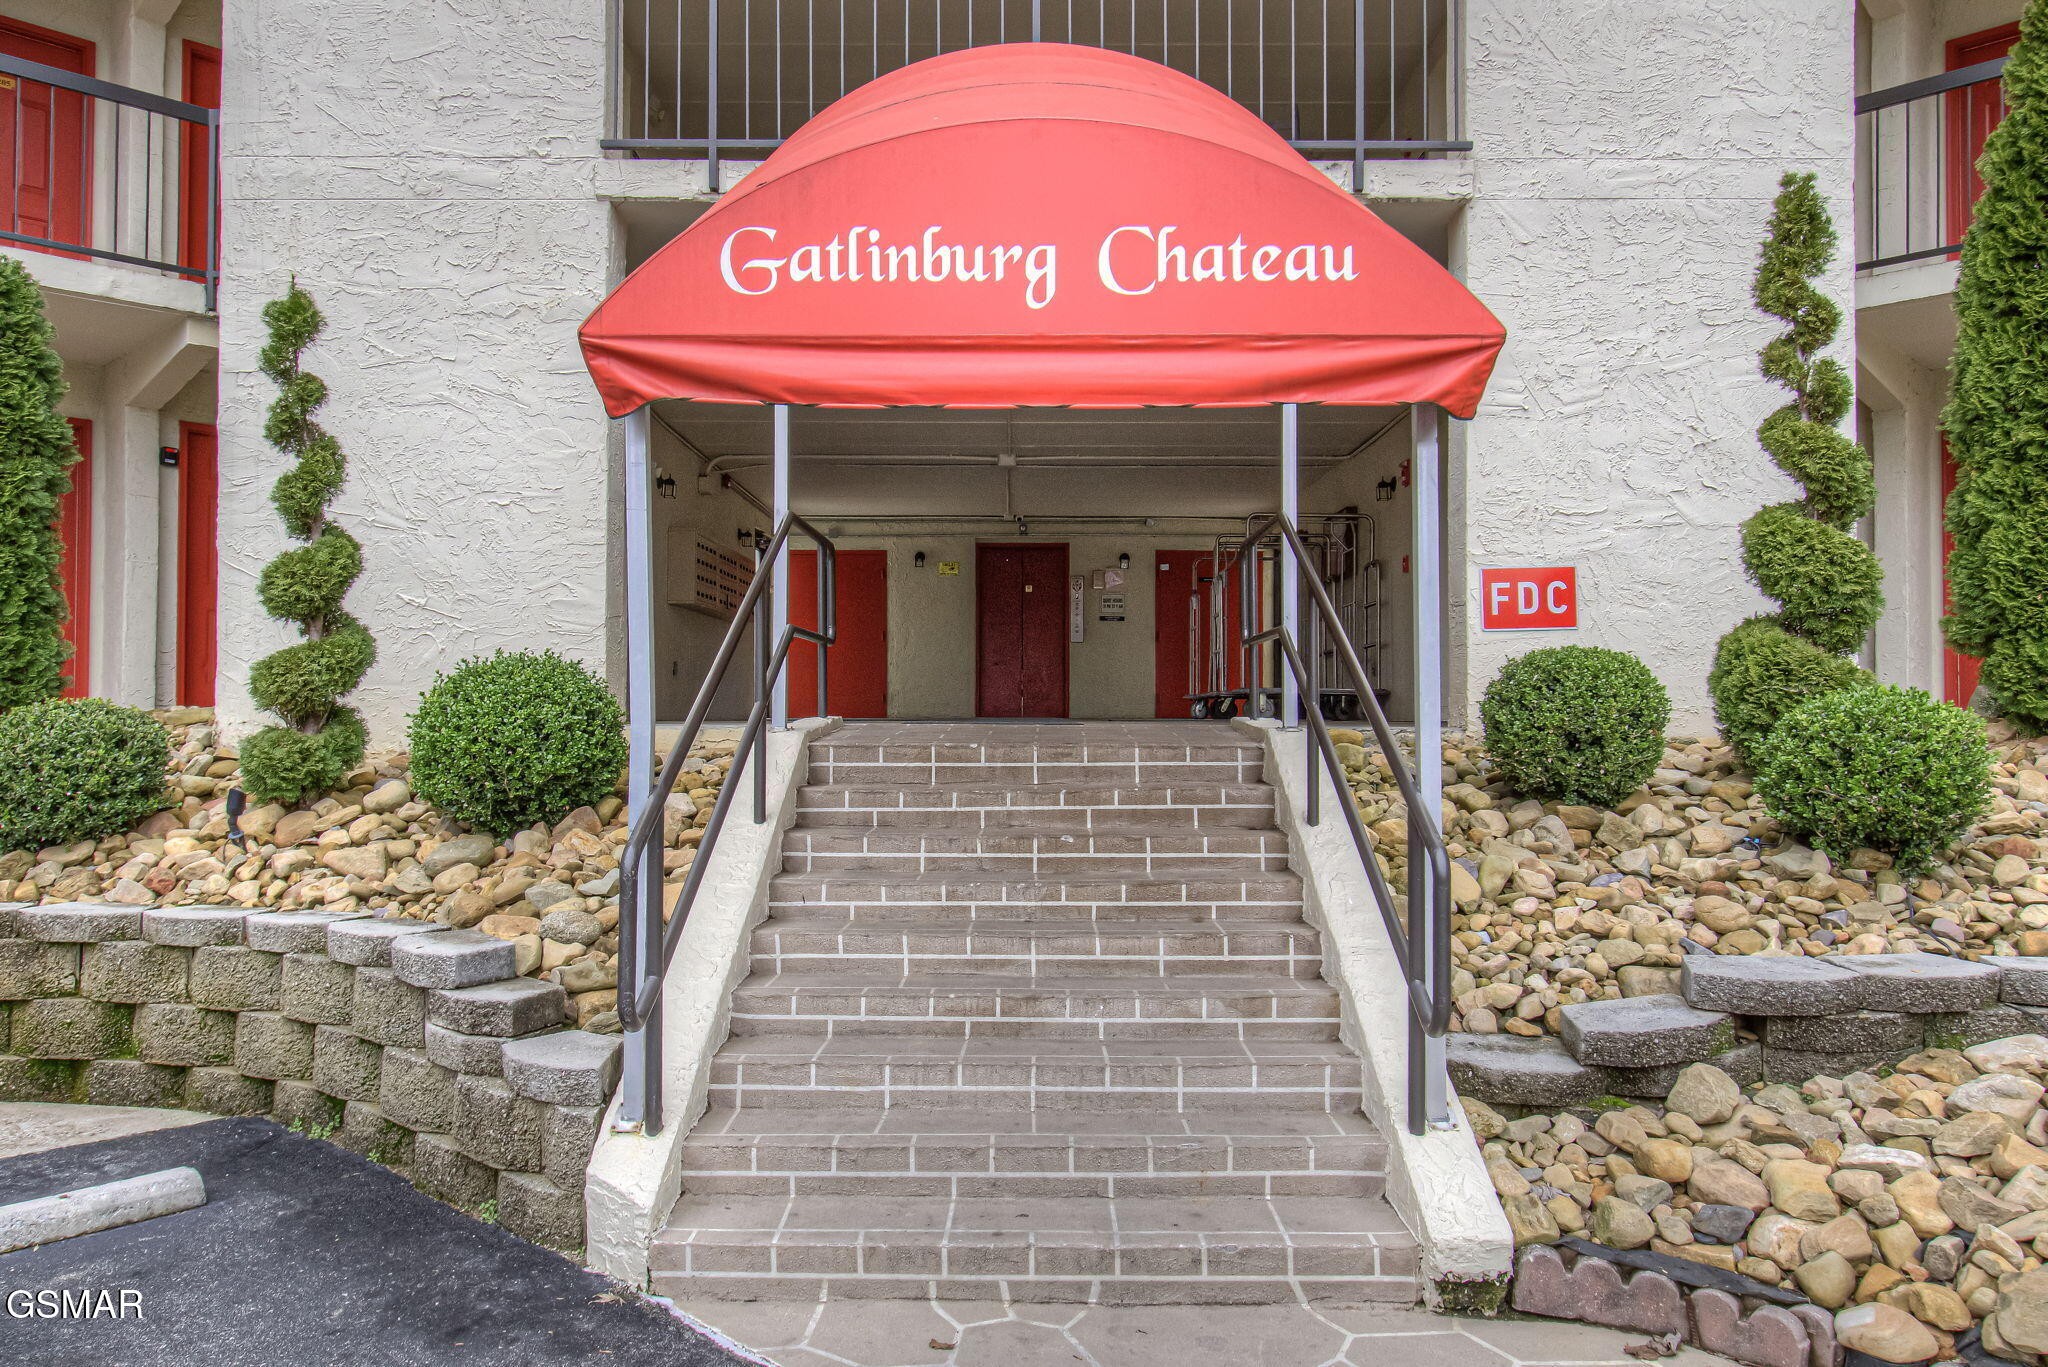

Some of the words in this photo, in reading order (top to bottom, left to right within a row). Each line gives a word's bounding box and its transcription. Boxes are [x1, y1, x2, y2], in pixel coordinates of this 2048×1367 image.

[720, 226, 1056, 310] Gatlinburg
[1098, 225, 1360, 295] Chateau
[1491, 581, 1568, 615] FDC
